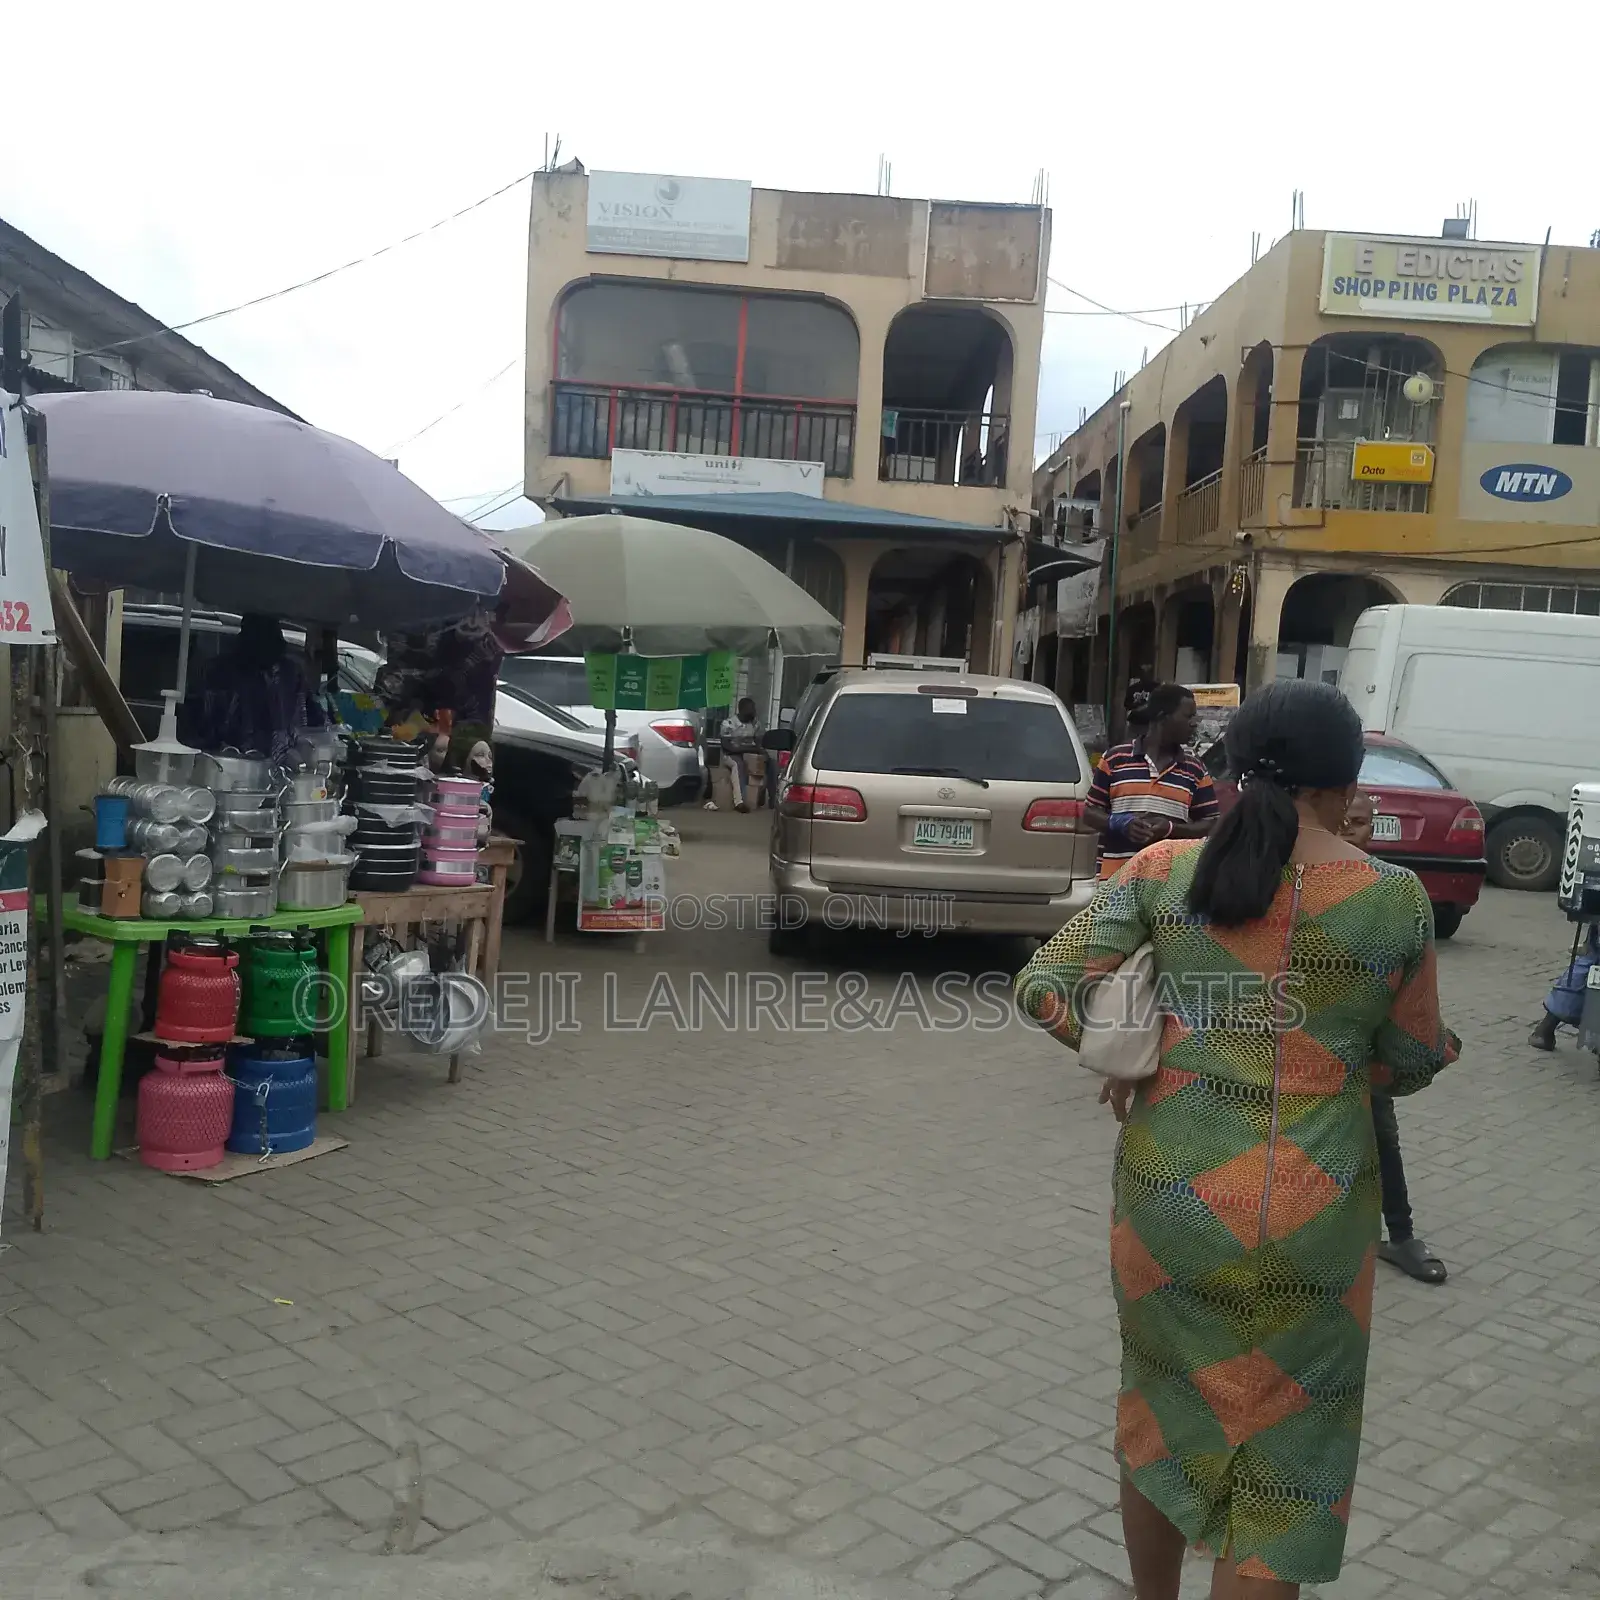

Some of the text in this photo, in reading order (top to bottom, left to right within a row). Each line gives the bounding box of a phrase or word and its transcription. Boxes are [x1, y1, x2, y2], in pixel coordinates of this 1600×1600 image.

[598, 201, 674, 219] VISION
[1397, 246, 1523, 283] EDICTAS
[1333, 276, 1518, 306] SHOPPING PLAZA
[1361, 465, 1385, 475] Data
[1494, 471, 1557, 495] MTN
